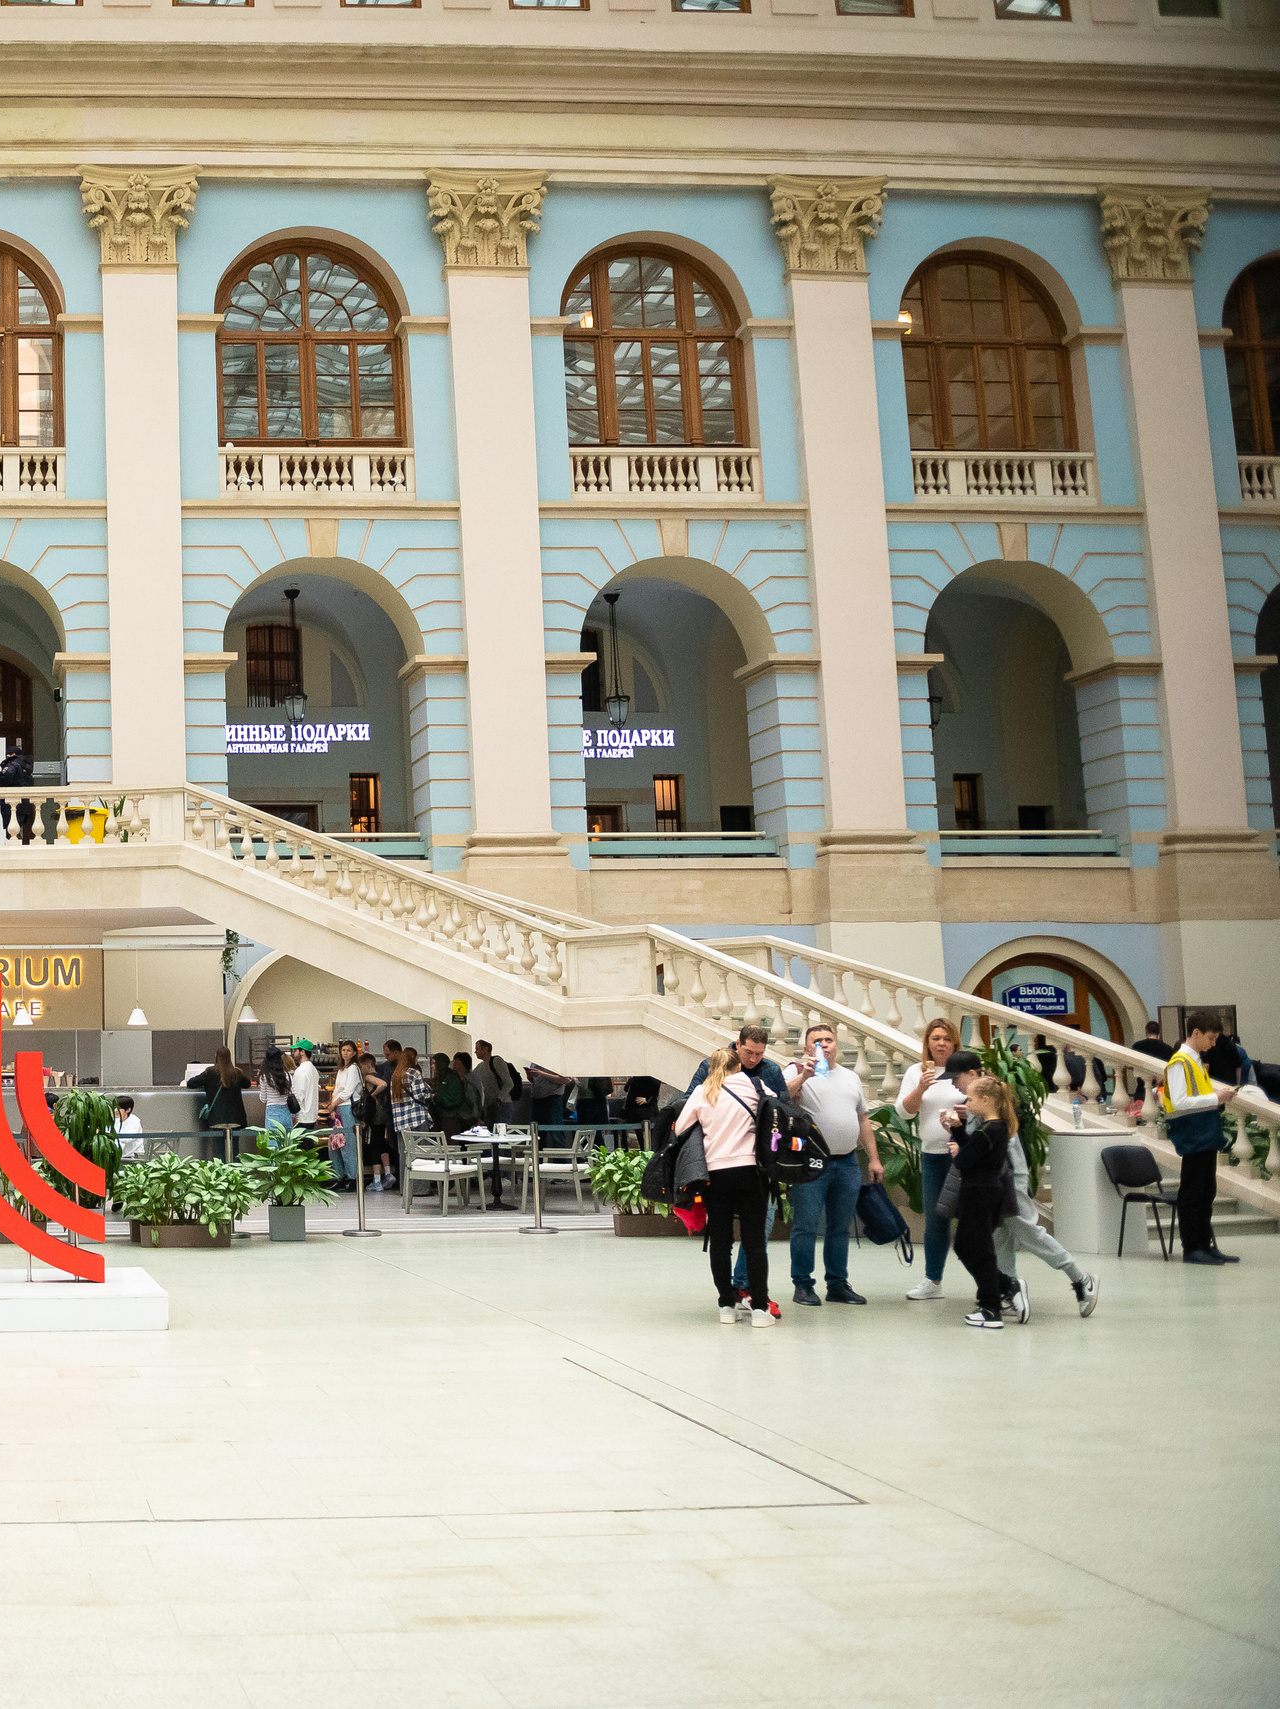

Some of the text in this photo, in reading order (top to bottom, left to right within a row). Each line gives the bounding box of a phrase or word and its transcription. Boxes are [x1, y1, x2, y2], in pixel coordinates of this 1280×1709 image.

[290, 724, 371, 744] ПОДАРКИ
[596, 729, 675, 749] ПОДАРКИ
[226, 743, 329, 753] АНТИКВАРНАЯ ГАЛЕРЕЯ
[581, 748, 634, 758] АЯ ГАЛЕРЕЯ
[1020, 987, 1055, 996] ВЫХОД
[1, 1001, 41, 1016] AFE
[809, 1158, 823, 1169] 28
